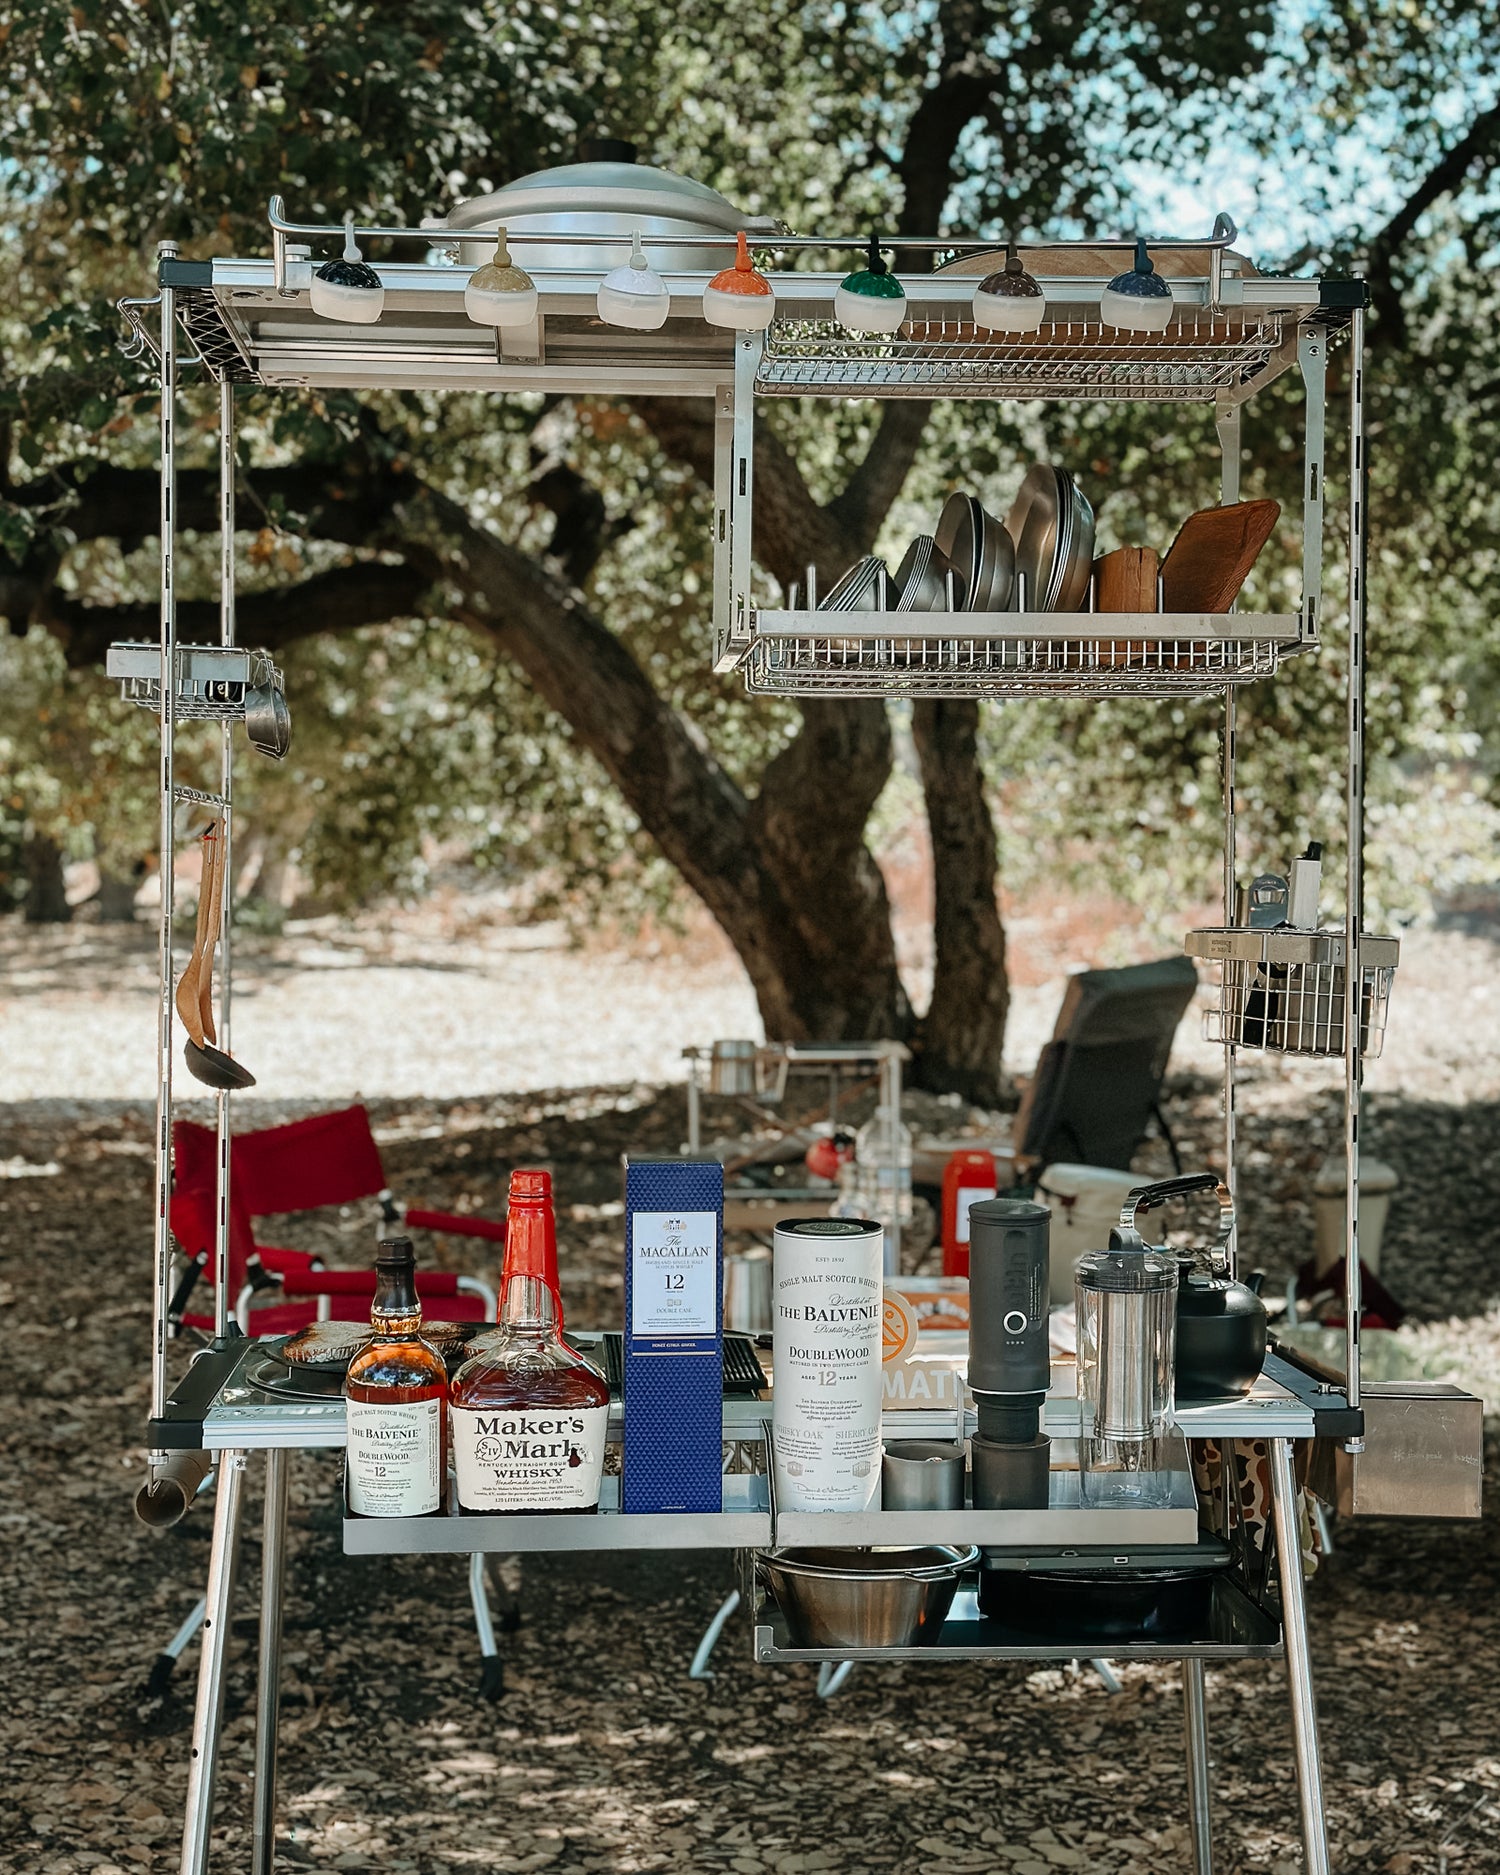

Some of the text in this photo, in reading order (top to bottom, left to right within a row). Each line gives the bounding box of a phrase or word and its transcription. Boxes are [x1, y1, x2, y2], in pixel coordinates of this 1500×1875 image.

[665, 1235, 681, 1246] The
[639, 1247, 709, 1257] MACALLAN
[664, 1274, 684, 1289] 12
[780, 1277, 800, 1290] SINGLE
[802, 1275, 823, 1283] MALT
[826, 1275, 856, 1283] SCOTCH
[779, 1303, 880, 1321] THE BALVENIE
[818, 1371, 837, 1386] 12
[474, 1417, 584, 1435] Maker's
[352, 1428, 419, 1439] THE BALVENIE
[803, 1430, 824, 1439] OAK
[836, 1429, 866, 1439] SHERRY
[375, 1467, 386, 1477] 12
[494, 1468, 566, 1478] WHISKY
